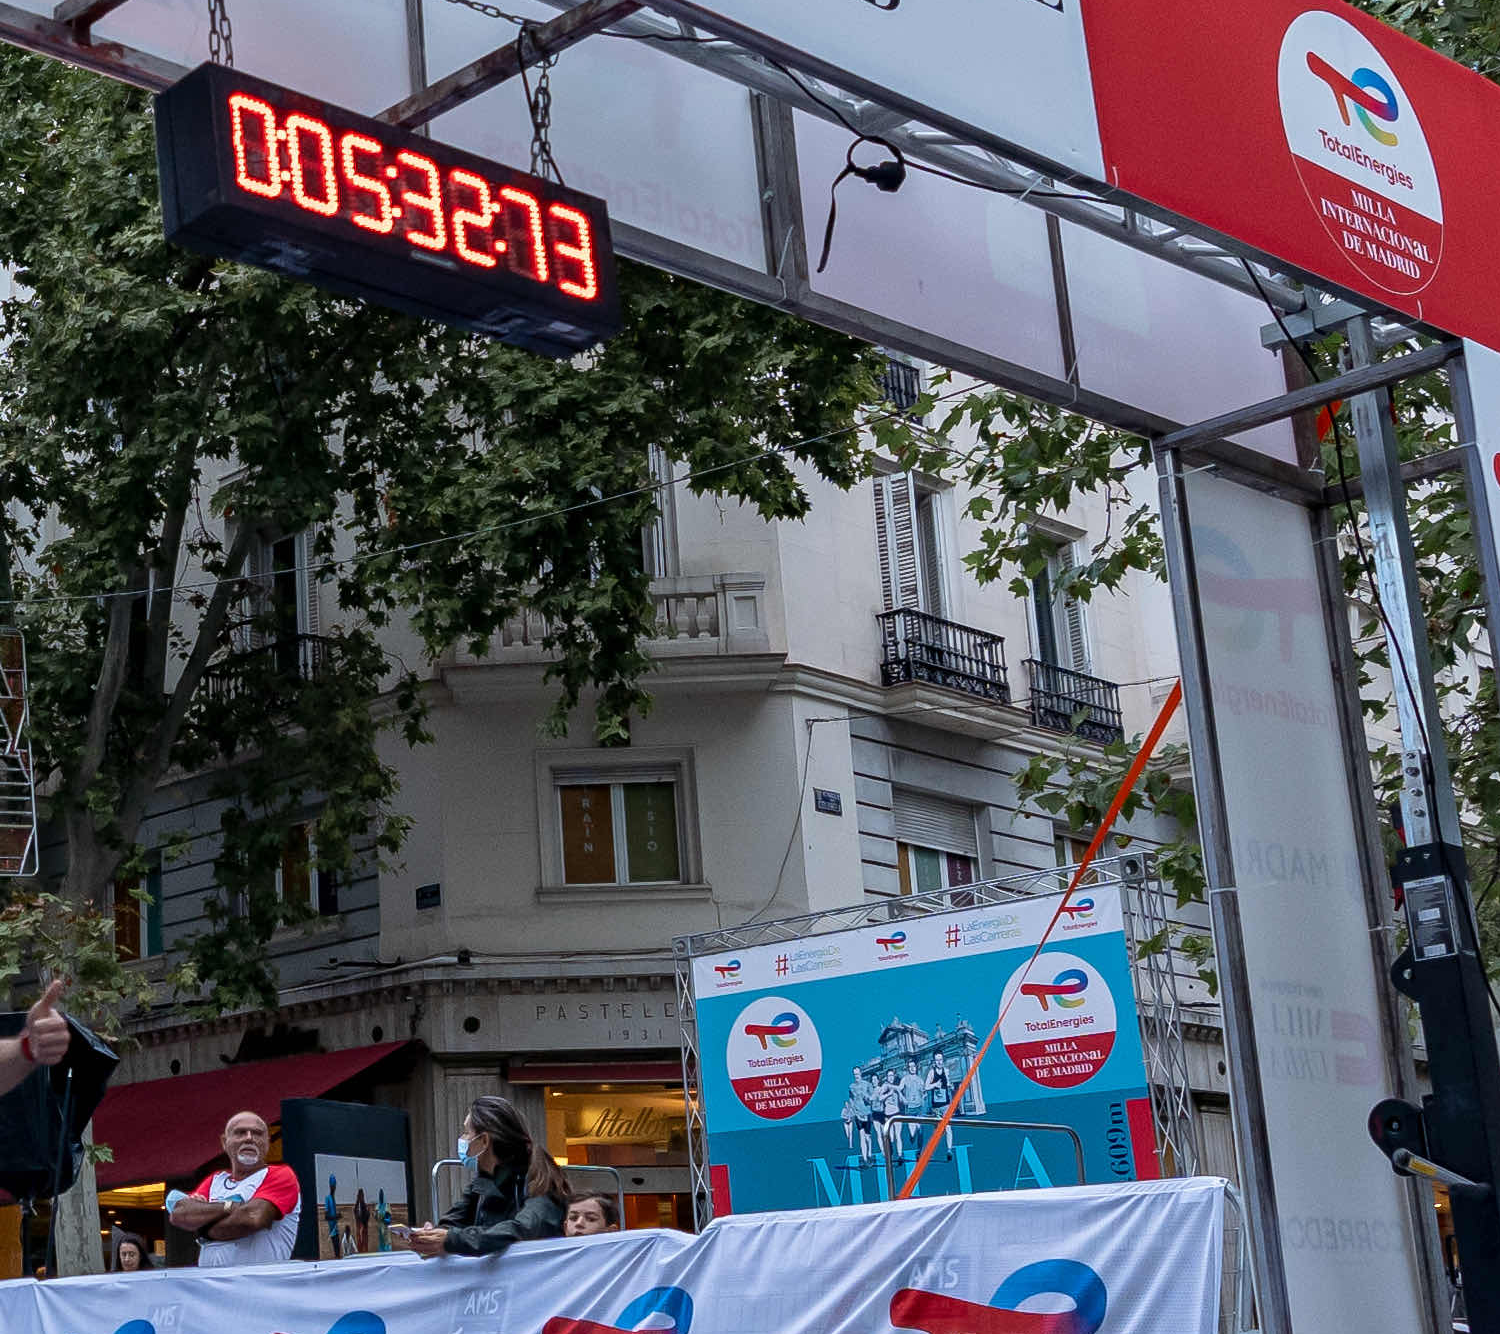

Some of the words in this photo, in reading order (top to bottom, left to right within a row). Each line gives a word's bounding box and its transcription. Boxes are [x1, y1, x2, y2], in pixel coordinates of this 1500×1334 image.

[1318, 128, 1414, 190] TotalEnergies
[1351, 190, 1396, 225] MILLA
[1342, 230, 1365, 254] DE
[1366, 240, 1421, 280] MADRID
[1024, 1015, 1094, 1032] TotalEnergies
[608, 1029, 663, 1040] 1931
[1045, 1041, 1078, 1054] MILLA
[746, 1053, 805, 1068] TotalEnergies
[1036, 1068, 1051, 1079] DE
[1052, 1063, 1094, 1076] MADRID
[762, 1077, 791, 1088] MILLA
[755, 1101, 768, 1110] DE
[768, 1097, 803, 1109] MADRID
